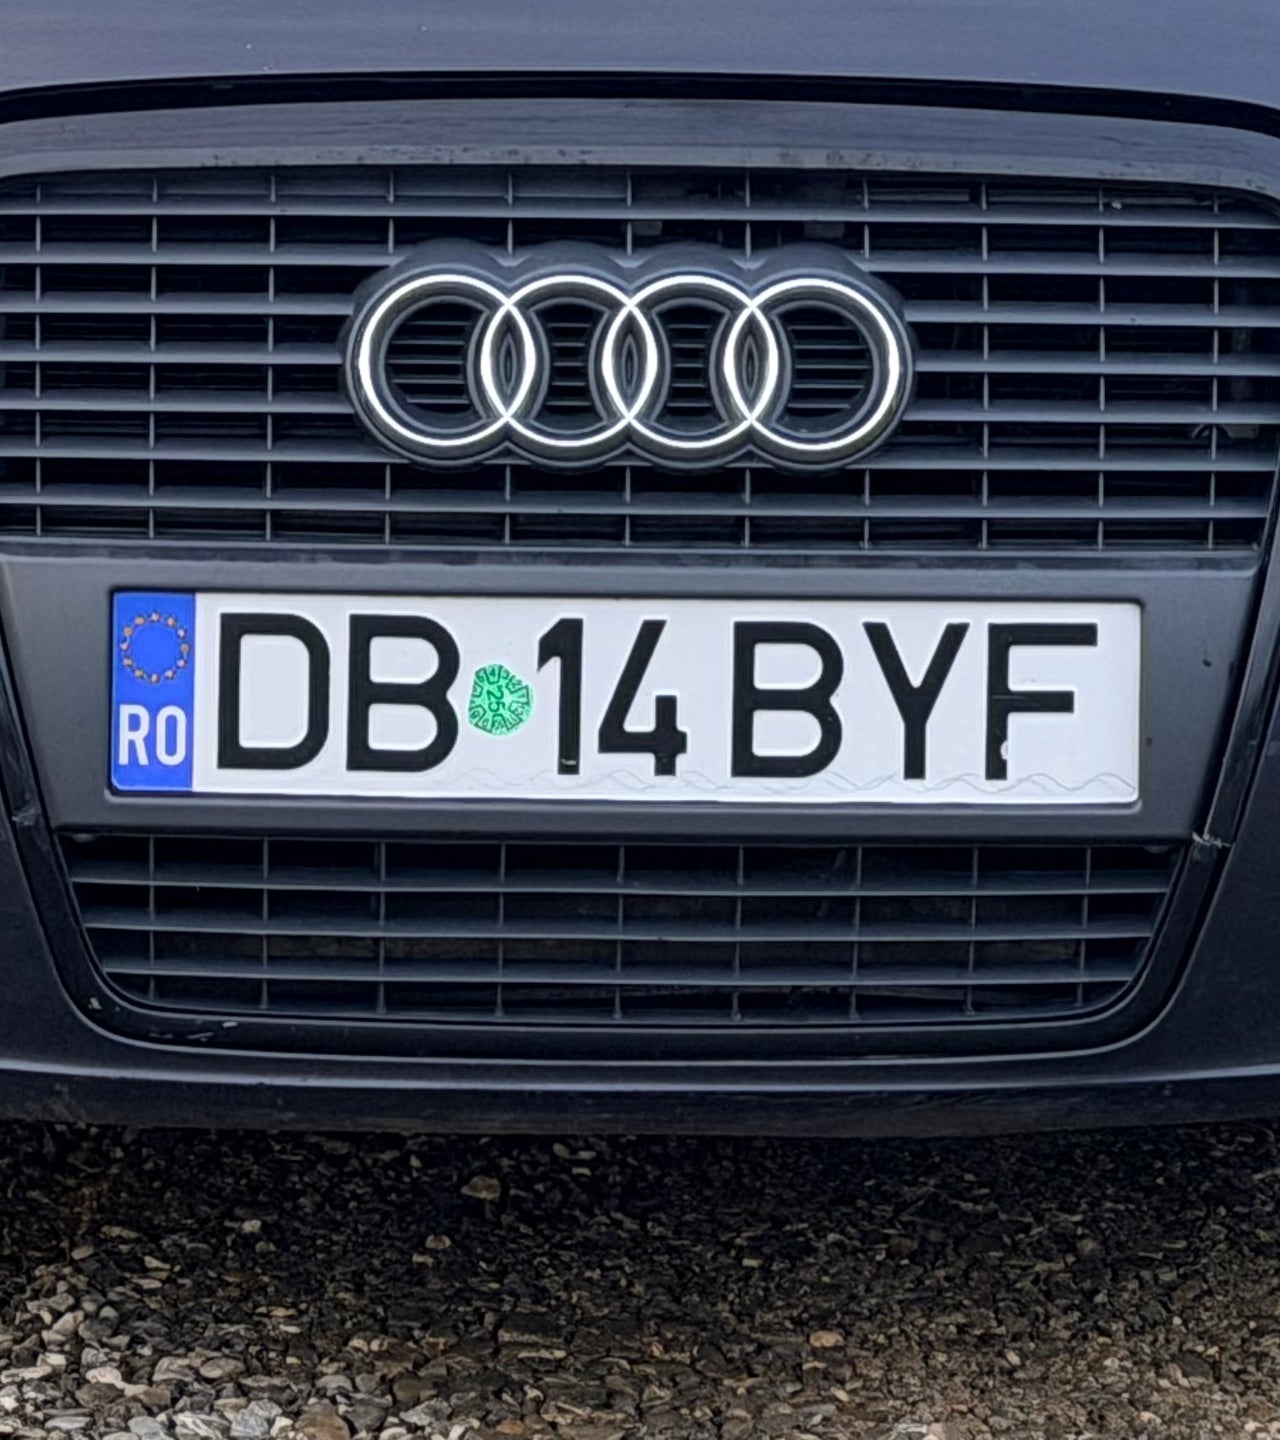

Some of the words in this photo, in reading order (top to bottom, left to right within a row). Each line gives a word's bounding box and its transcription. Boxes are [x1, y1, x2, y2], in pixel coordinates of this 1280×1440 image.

[118, 704, 187, 766] RO
[216, 612, 461, 773] DB
[537, 617, 688, 777] 14
[730, 621, 1098, 781] BYF
